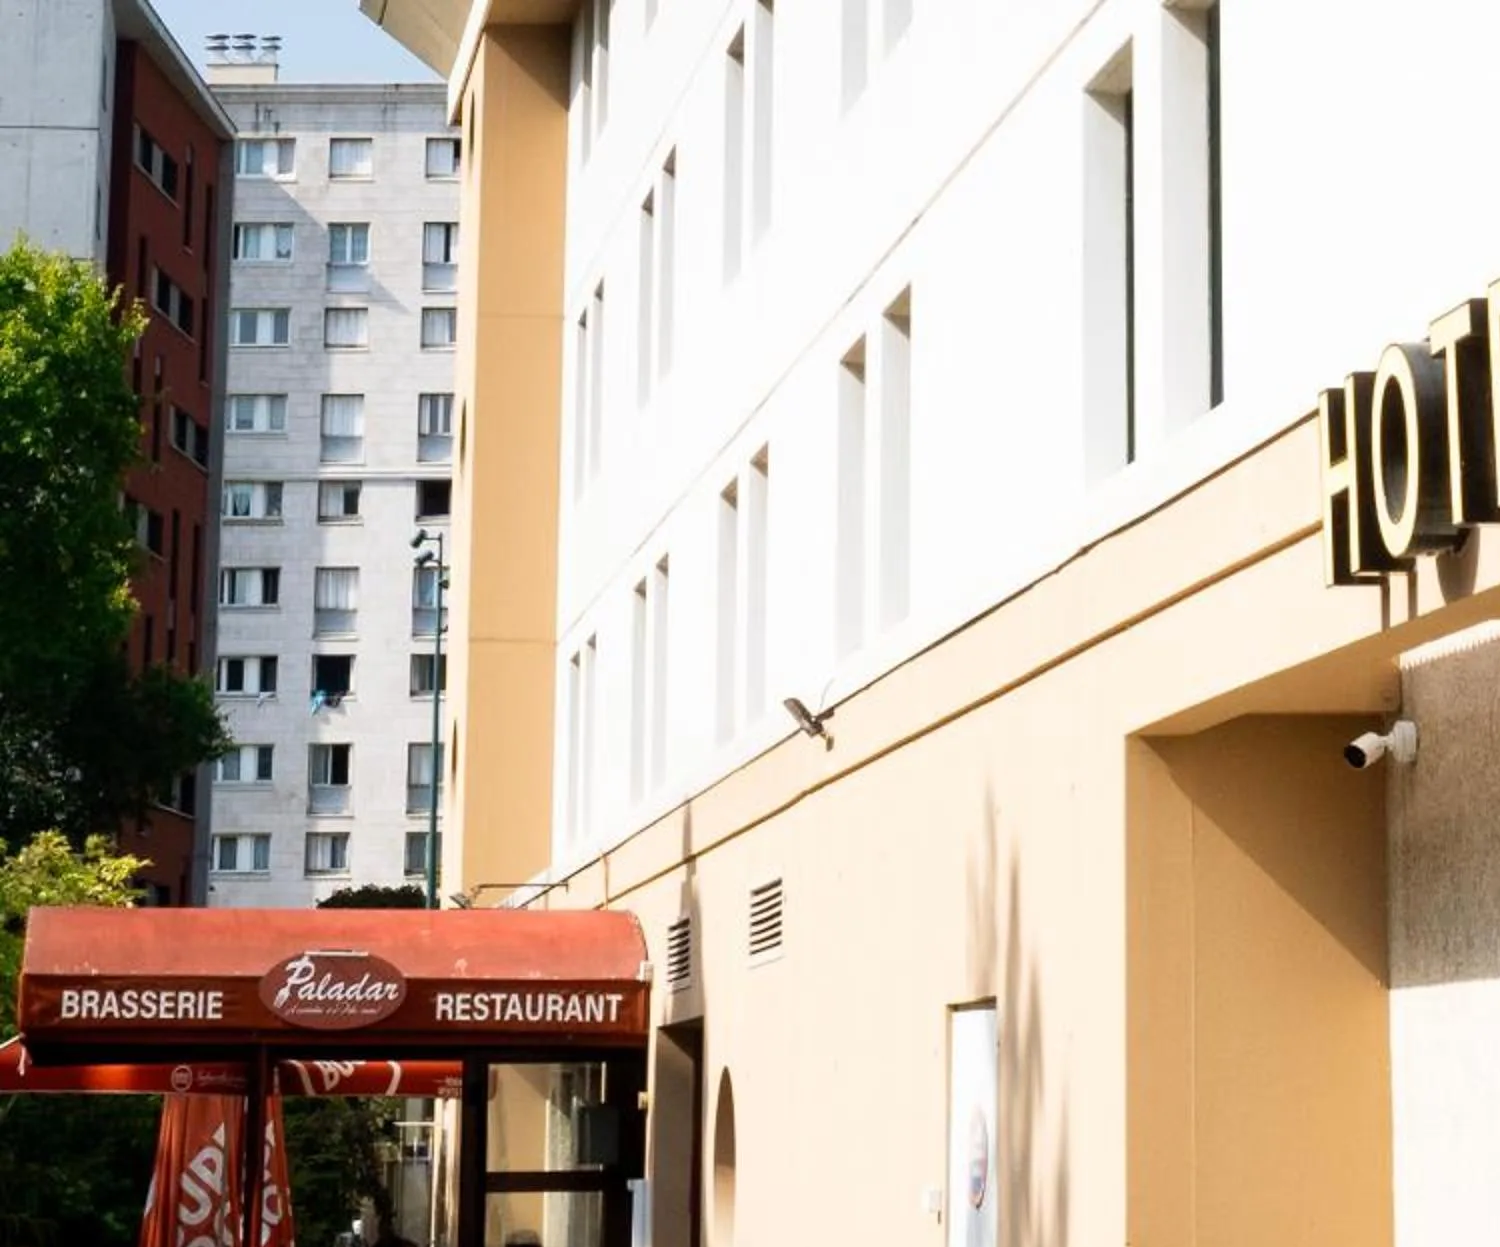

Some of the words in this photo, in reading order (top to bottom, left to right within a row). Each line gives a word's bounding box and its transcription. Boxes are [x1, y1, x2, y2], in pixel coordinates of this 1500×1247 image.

[273, 955, 399, 1008] Paladar
[61, 989, 223, 1019] BRASSERIE
[435, 993, 624, 1022] RESTAURANT
